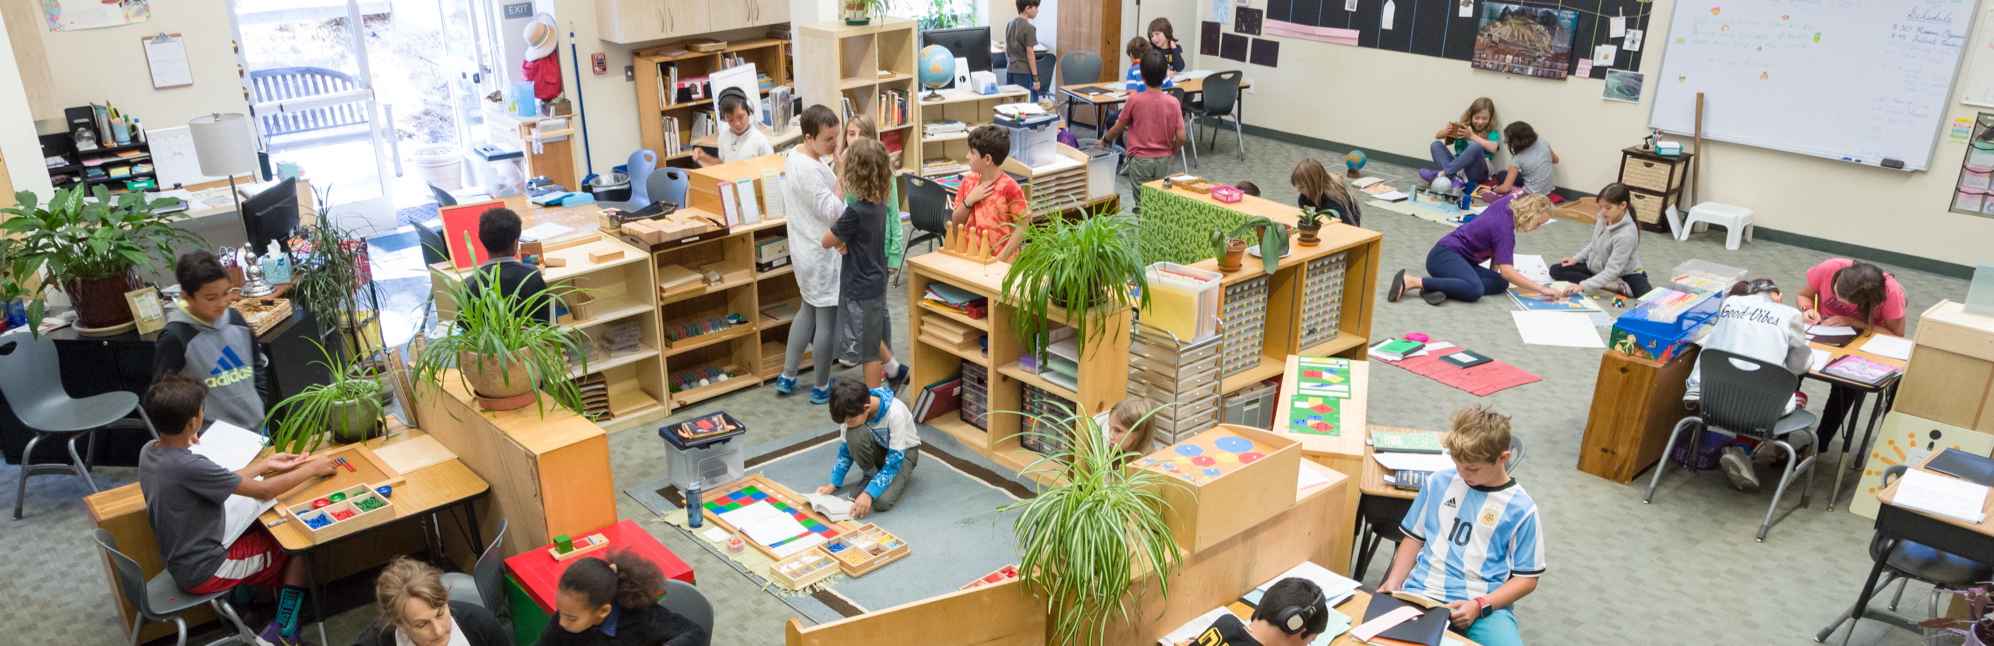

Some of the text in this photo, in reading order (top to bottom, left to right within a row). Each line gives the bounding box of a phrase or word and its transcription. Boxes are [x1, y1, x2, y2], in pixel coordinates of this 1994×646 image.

[508, 5, 528, 16] EXIT
[1720, 303, 1780, 326] Good Vibes
[204, 366, 252, 388] adidas
[1447, 516, 1473, 547] 10
